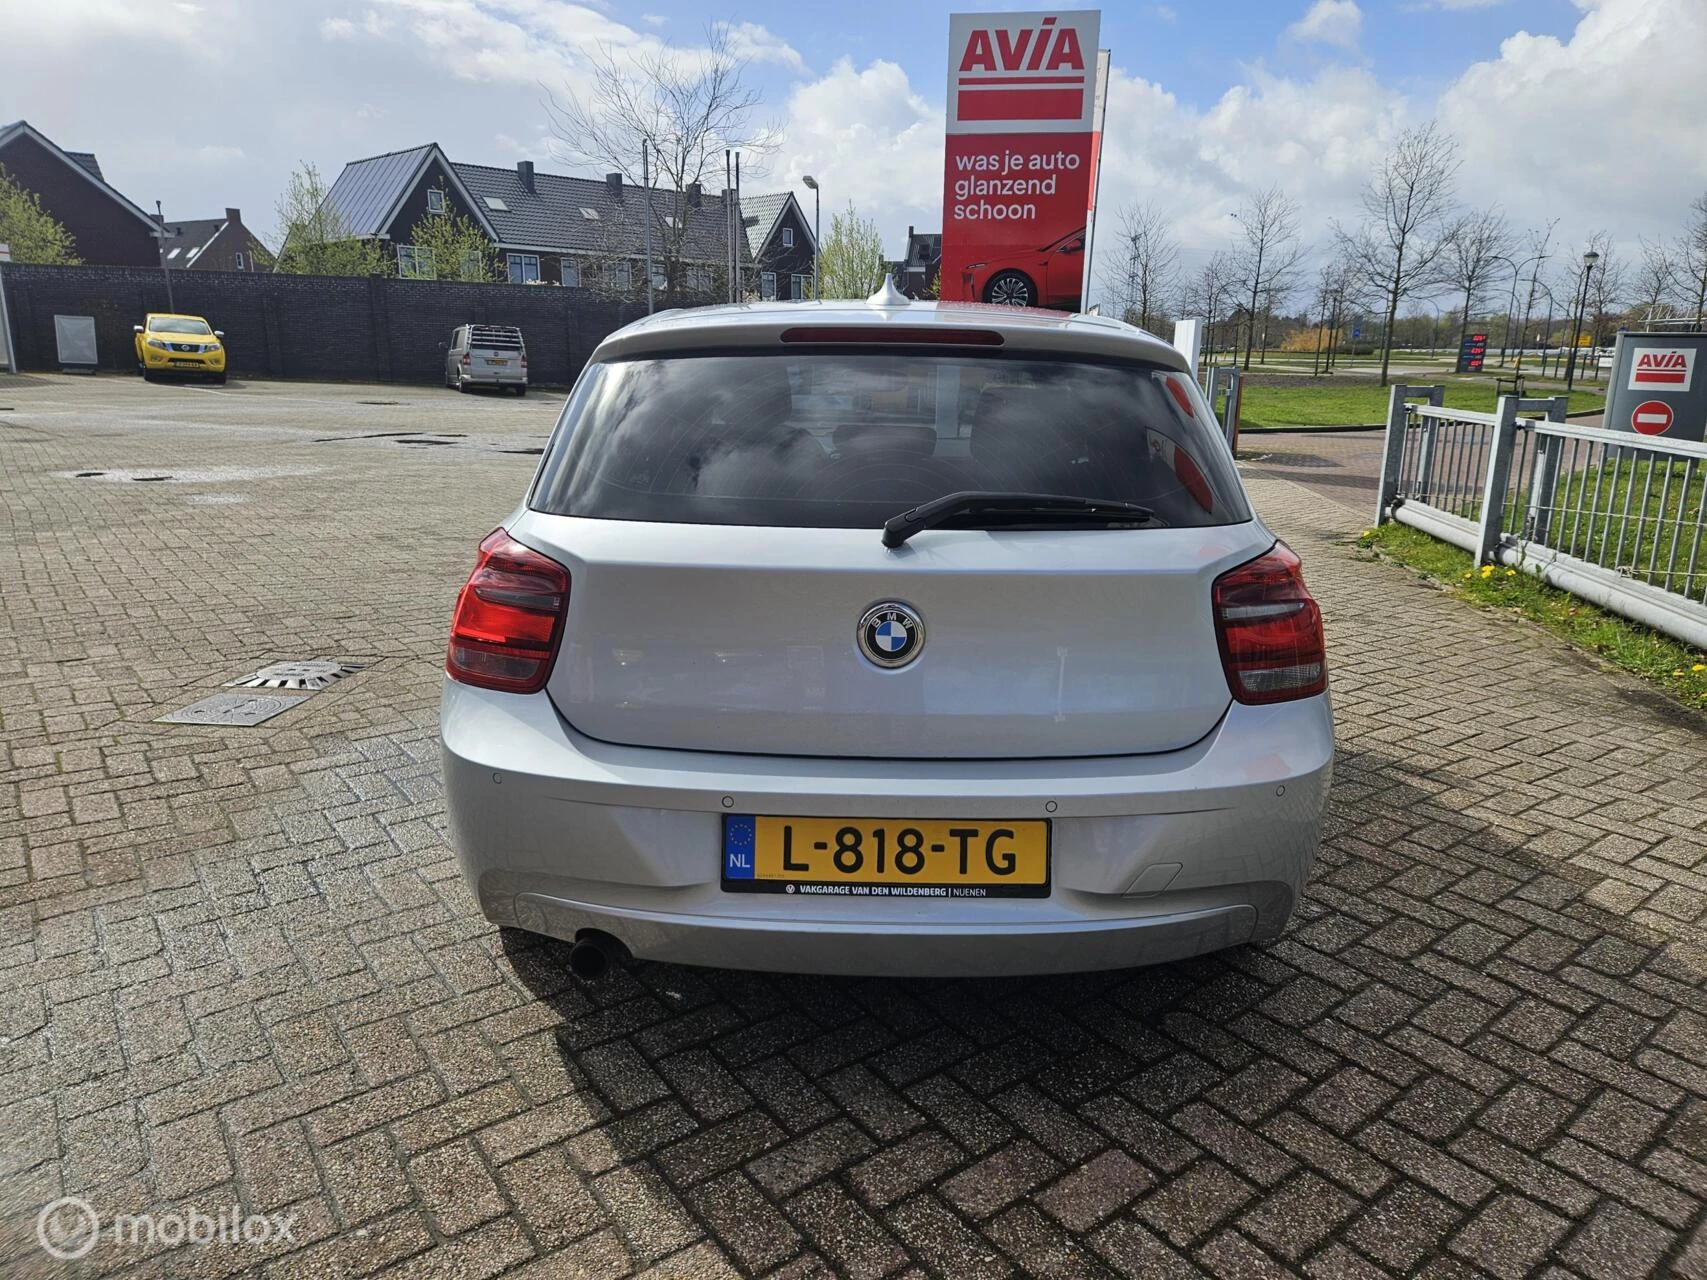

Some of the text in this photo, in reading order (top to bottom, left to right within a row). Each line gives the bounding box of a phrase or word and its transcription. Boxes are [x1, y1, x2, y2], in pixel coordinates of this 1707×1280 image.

[956, 150, 1080, 175] was je auto
[955, 175, 1056, 200] glanzend
[954, 200, 1036, 220] schoon
[871, 612, 914, 629] BMW
[783, 825, 1016, 876] L-818-TG
[730, 854, 750, 868] NL
[800, 884, 850, 894] VAKGARAGE
[852, 886, 870, 895] VAN
[871, 887, 889, 895] DEN
[891, 887, 947, 896] WILDENBERG
[953, 888, 986, 897] NUENEN
